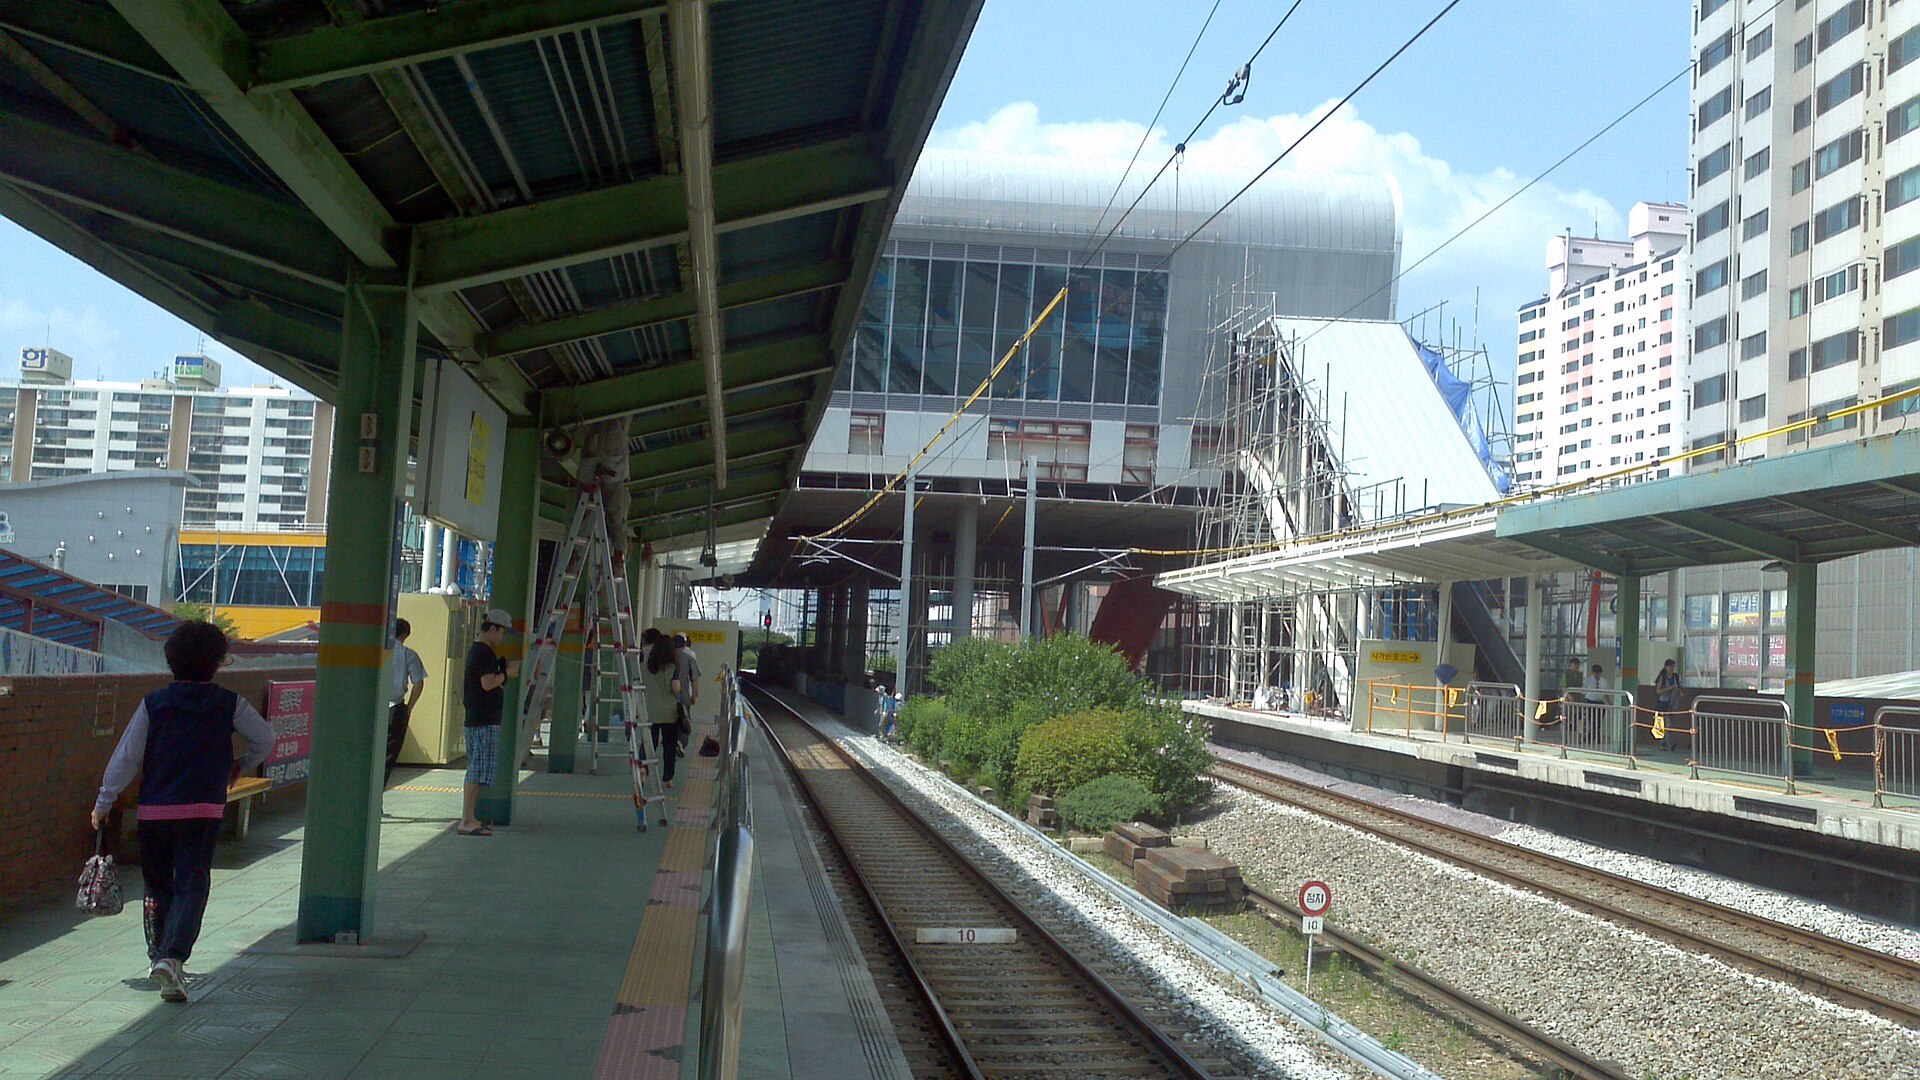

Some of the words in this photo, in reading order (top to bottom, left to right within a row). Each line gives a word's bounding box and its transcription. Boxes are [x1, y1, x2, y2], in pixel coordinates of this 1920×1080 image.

[1371, 652, 1391, 661] 나가는
[1307, 920, 1318, 930] 10
[957, 928, 976, 942] 10
